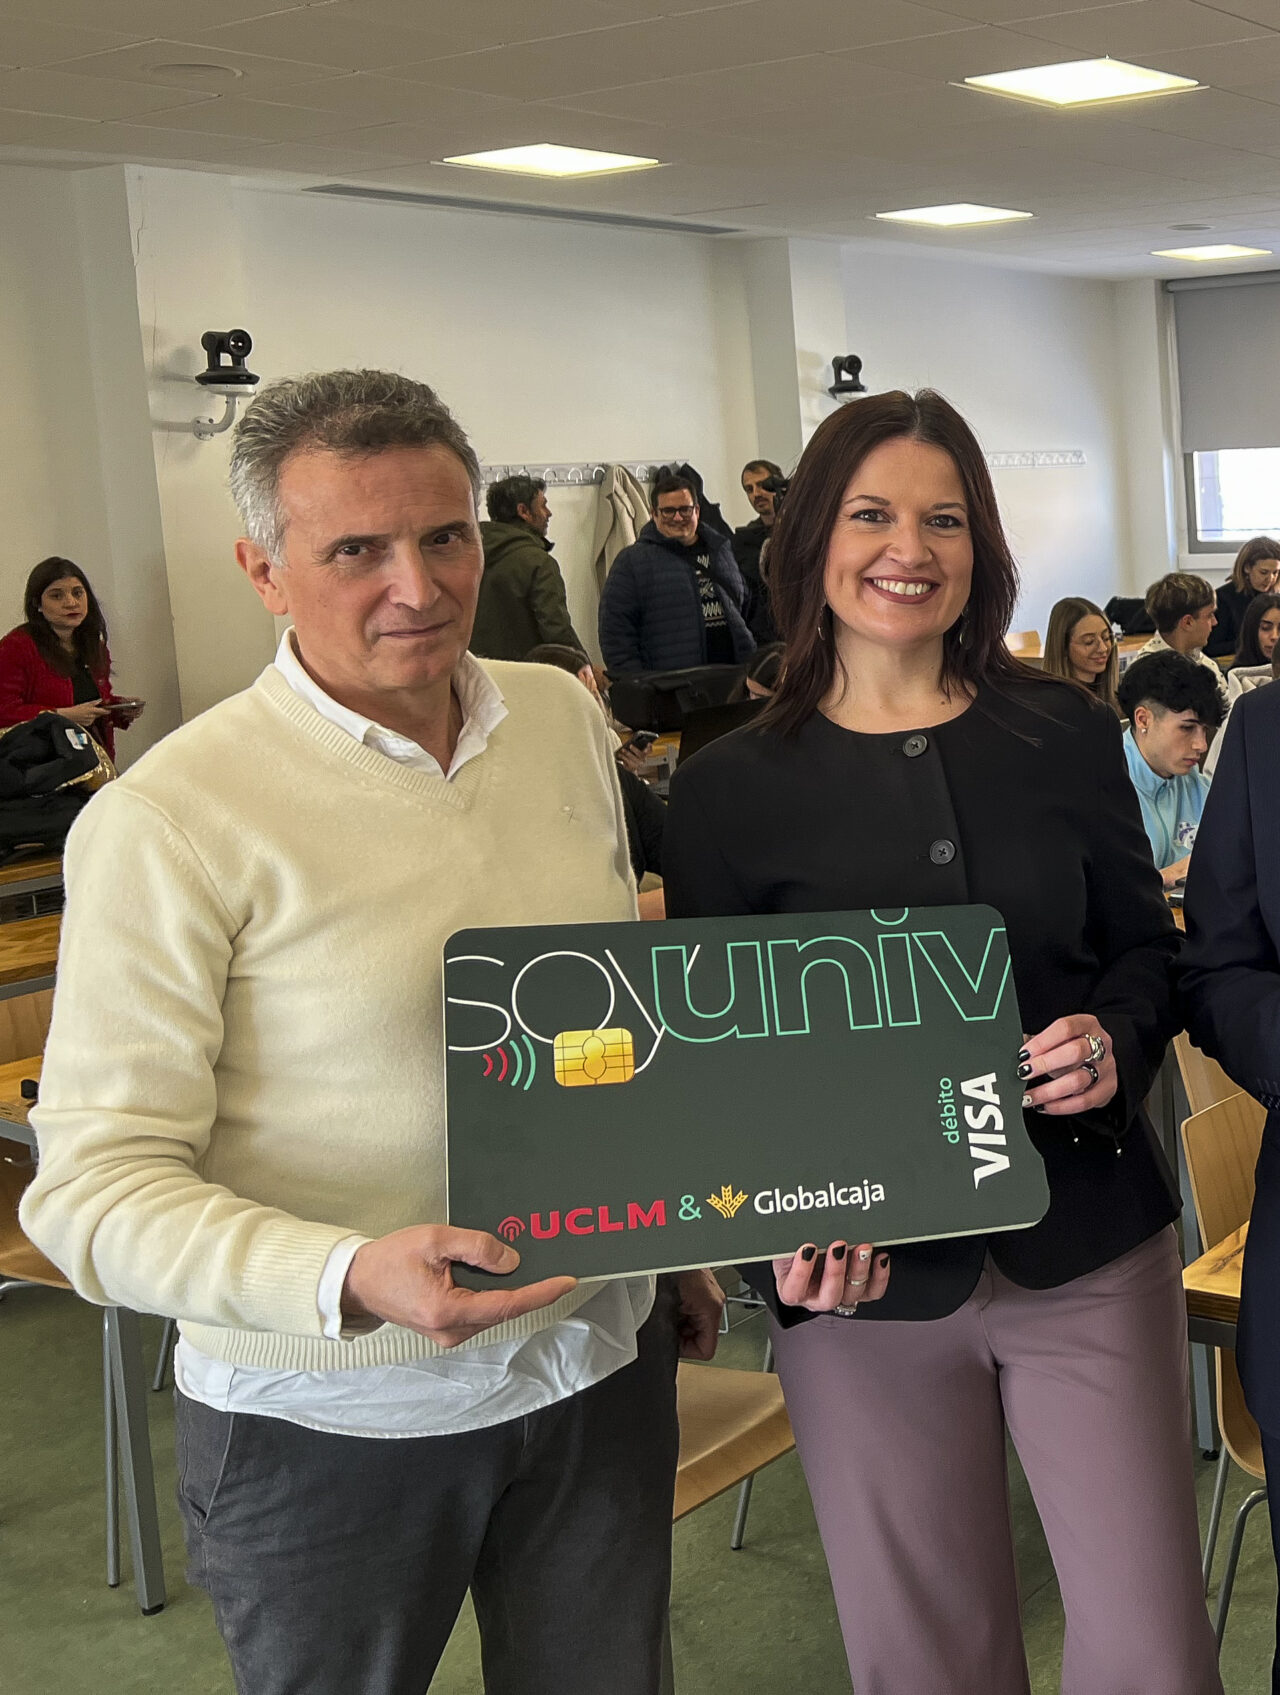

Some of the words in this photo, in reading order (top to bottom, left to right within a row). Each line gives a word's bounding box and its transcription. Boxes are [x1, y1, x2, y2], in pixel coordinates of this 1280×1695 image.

[939, 1077, 961, 1145] débito
[960, 1072, 1011, 1190] VISA
[529, 1199, 667, 1240] UCLM
[678, 1193, 702, 1221] &
[753, 1179, 886, 1215] Globalcaja
